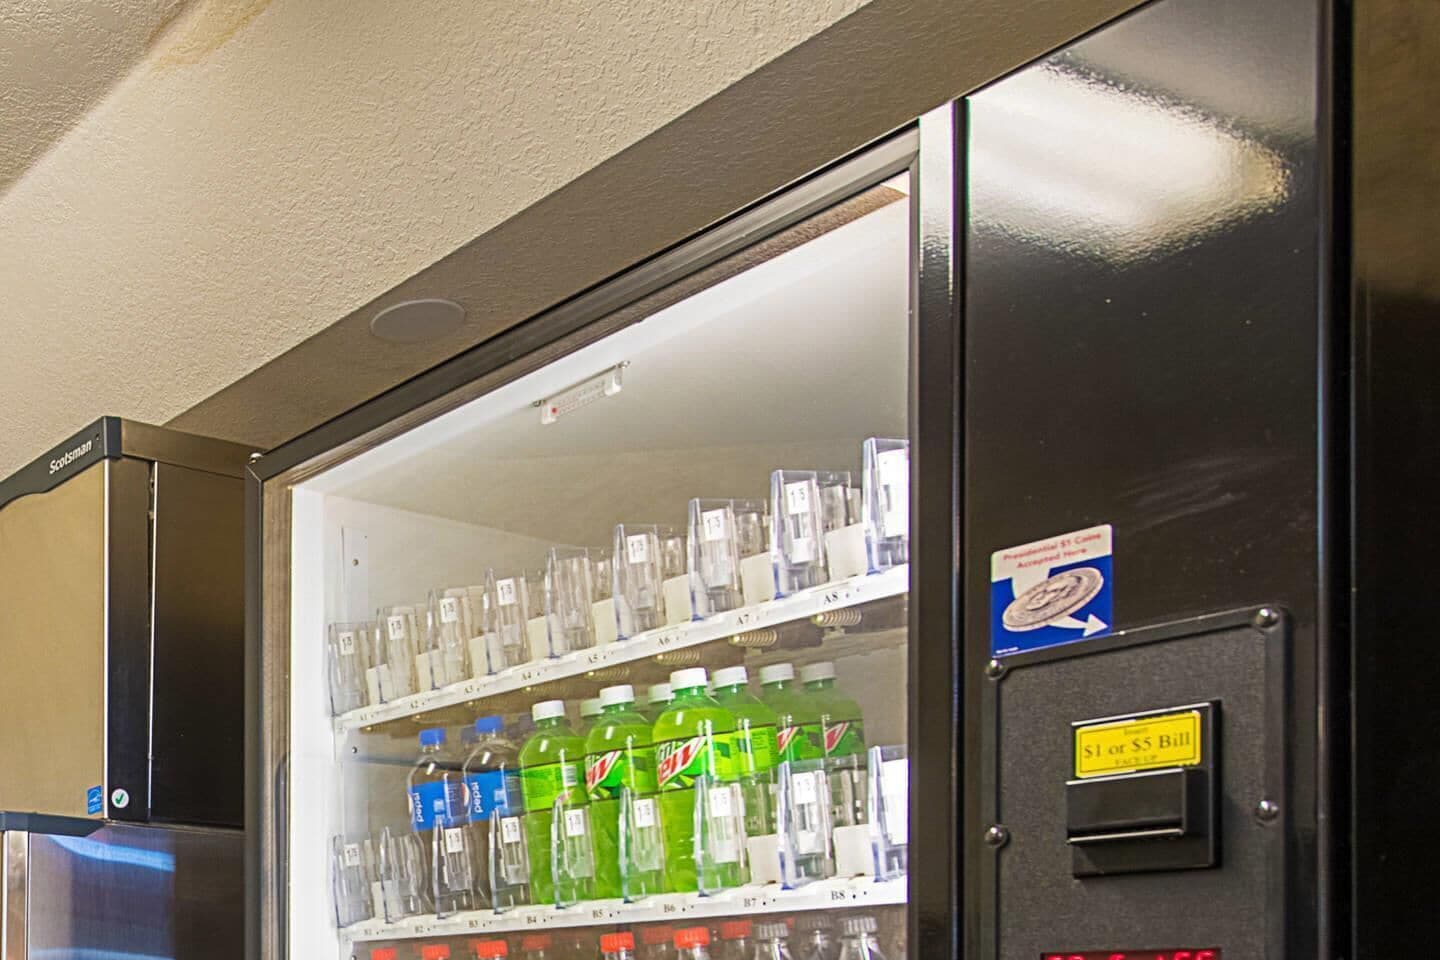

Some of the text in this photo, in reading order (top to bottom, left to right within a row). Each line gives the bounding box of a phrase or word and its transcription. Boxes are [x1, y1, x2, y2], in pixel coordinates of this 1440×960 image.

[49, 439, 92, 474] Scotsman
[1060, 539, 1072, 549] $1
[1017, 553, 1060, 569] Accepted
[824, 592, 838, 604] A8
[736, 614, 750, 626] A7
[1084, 732, 1190, 758] $1 or $5 Bill
[471, 782, 484, 813] pepsi
[414, 792, 424, 822] pepsi
[831, 891, 845, 900] B8
[664, 904, 676, 913] B6
[744, 899, 756, 908] B7
[593, 909, 603, 919] B5
[527, 916, 537, 925] B4
